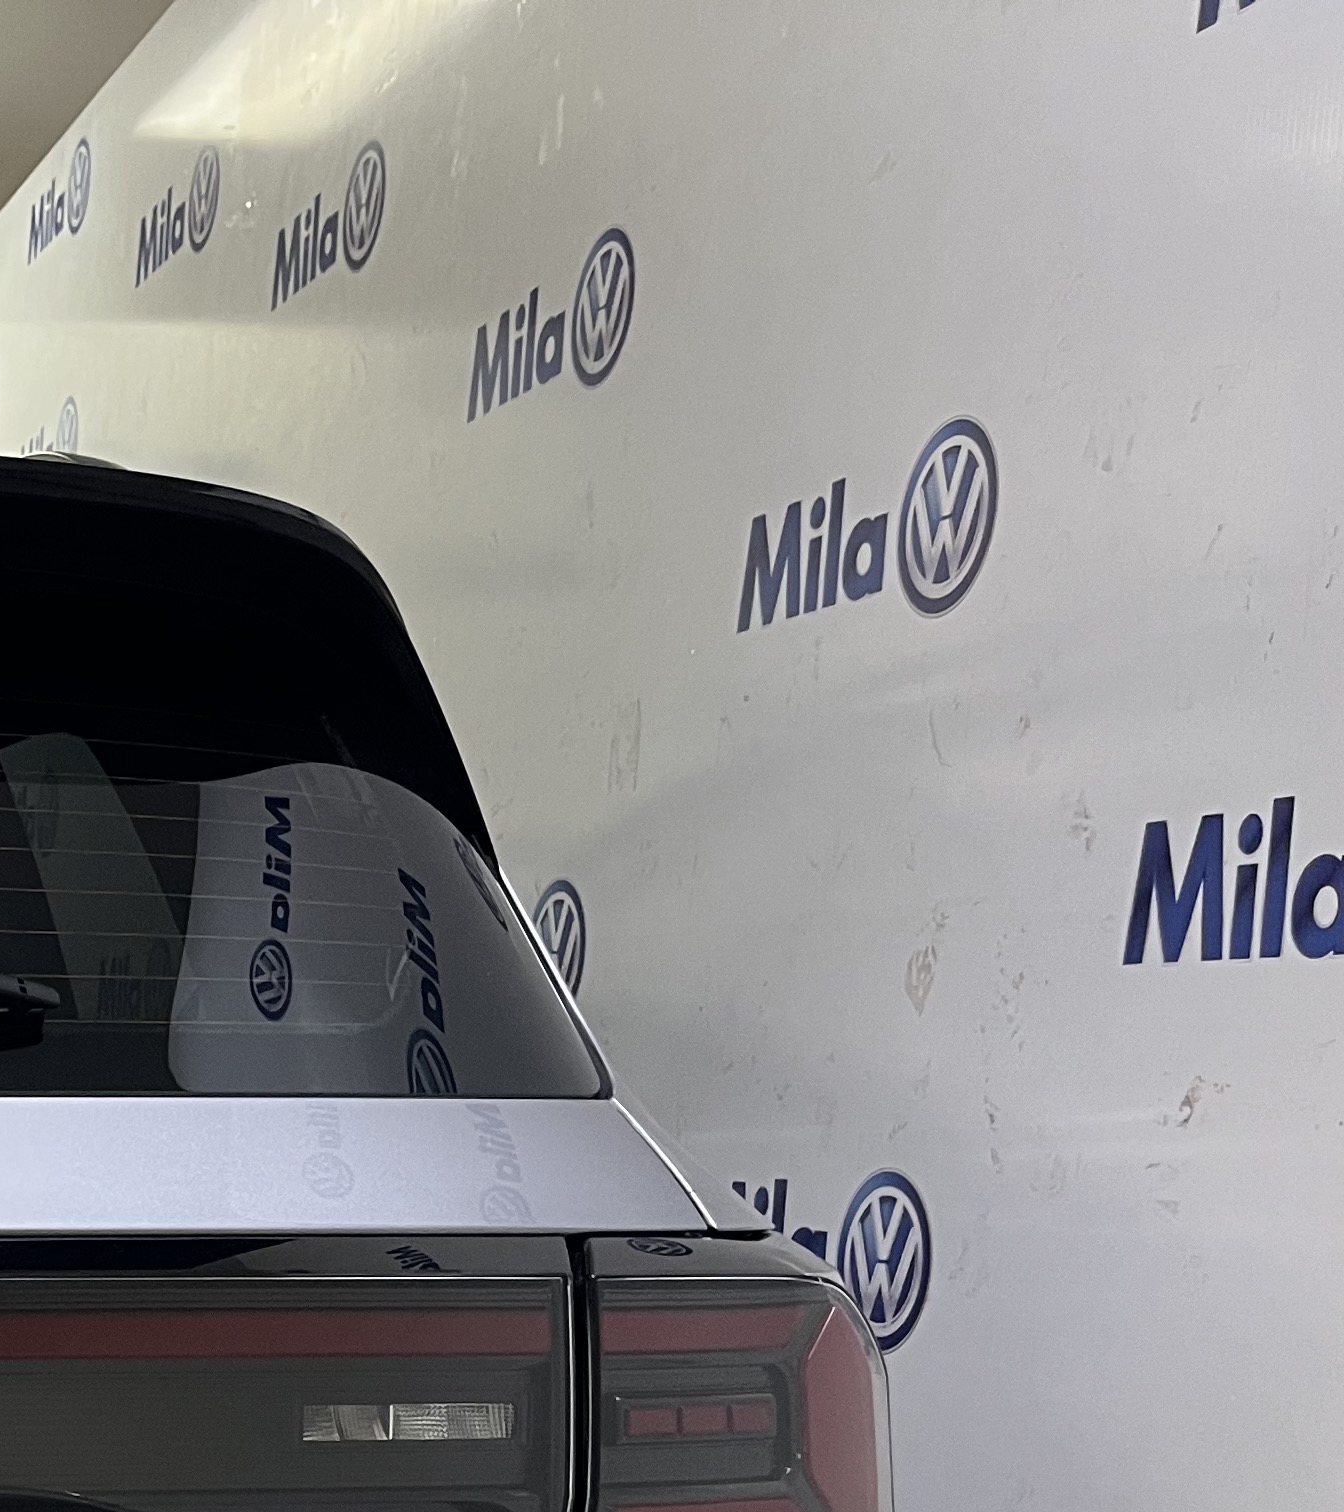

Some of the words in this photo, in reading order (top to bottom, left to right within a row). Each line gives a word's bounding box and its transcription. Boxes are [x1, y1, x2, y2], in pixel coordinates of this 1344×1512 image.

[27, 177, 66, 266] Mila
[135, 186, 187, 288] Mila
[271, 193, 340, 312] Mila
[467, 285, 566, 424] Mila
[736, 477, 890, 634] Mila
[1122, 795, 1344, 966] Mila
